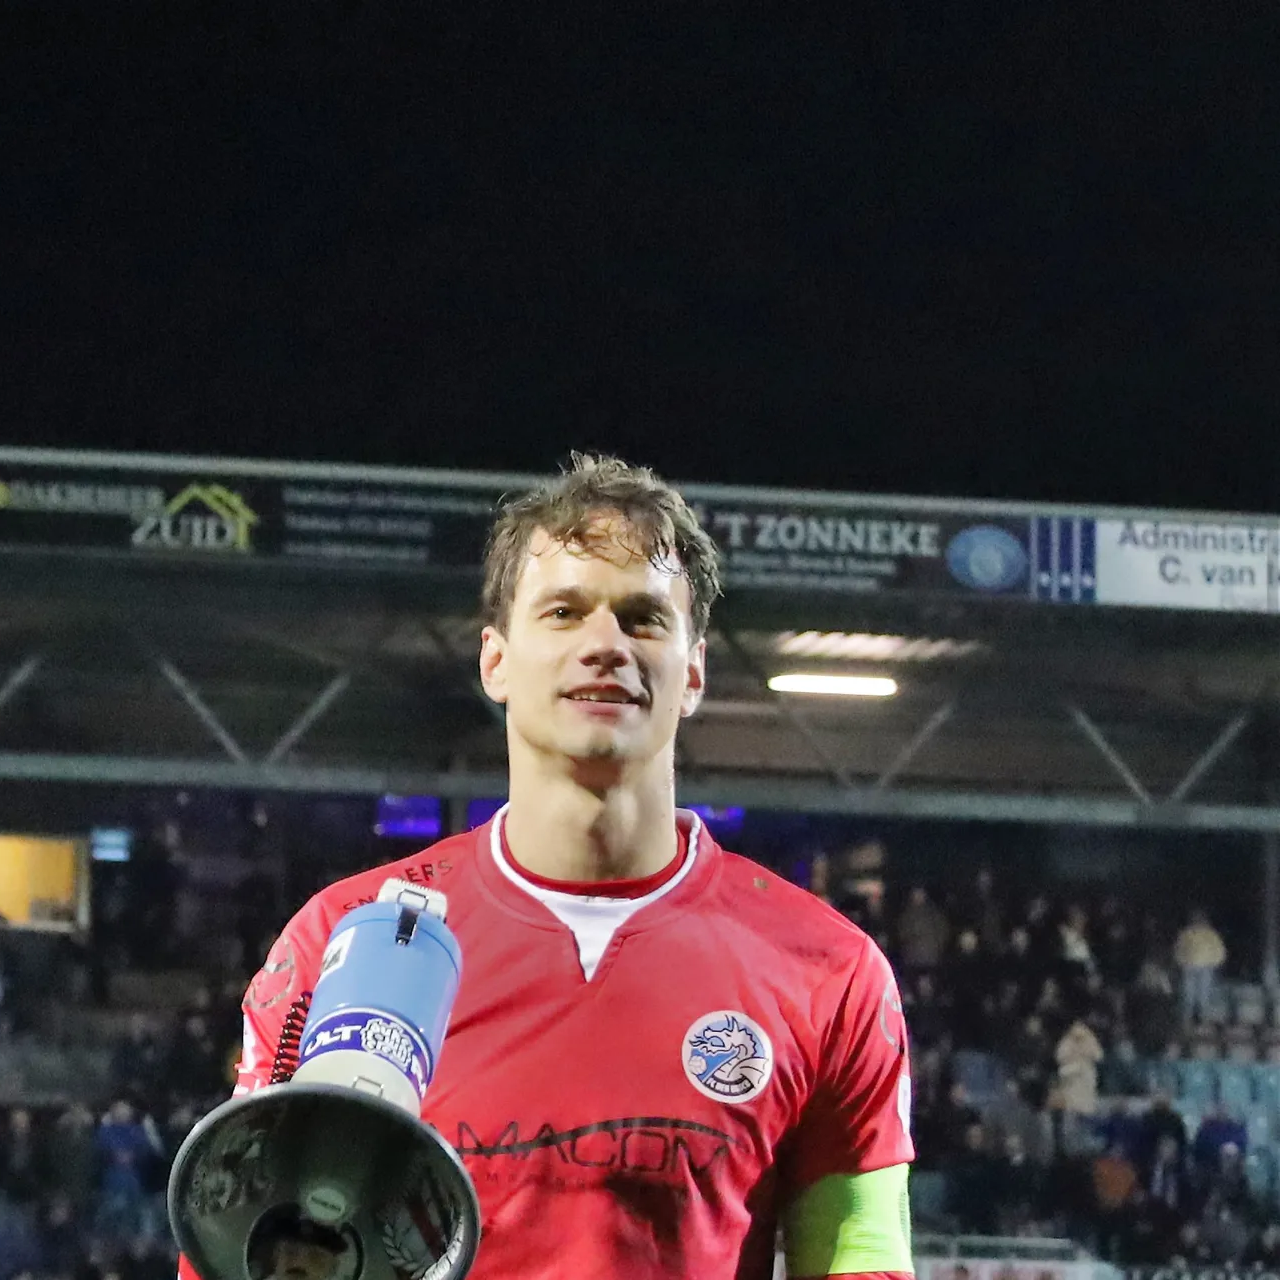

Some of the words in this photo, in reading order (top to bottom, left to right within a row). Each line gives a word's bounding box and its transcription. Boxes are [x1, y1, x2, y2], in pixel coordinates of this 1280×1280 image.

[753, 514, 939, 558] ZONNEKE
[1158, 555, 1190, 585] C.
[1201, 565, 1255, 585] van
